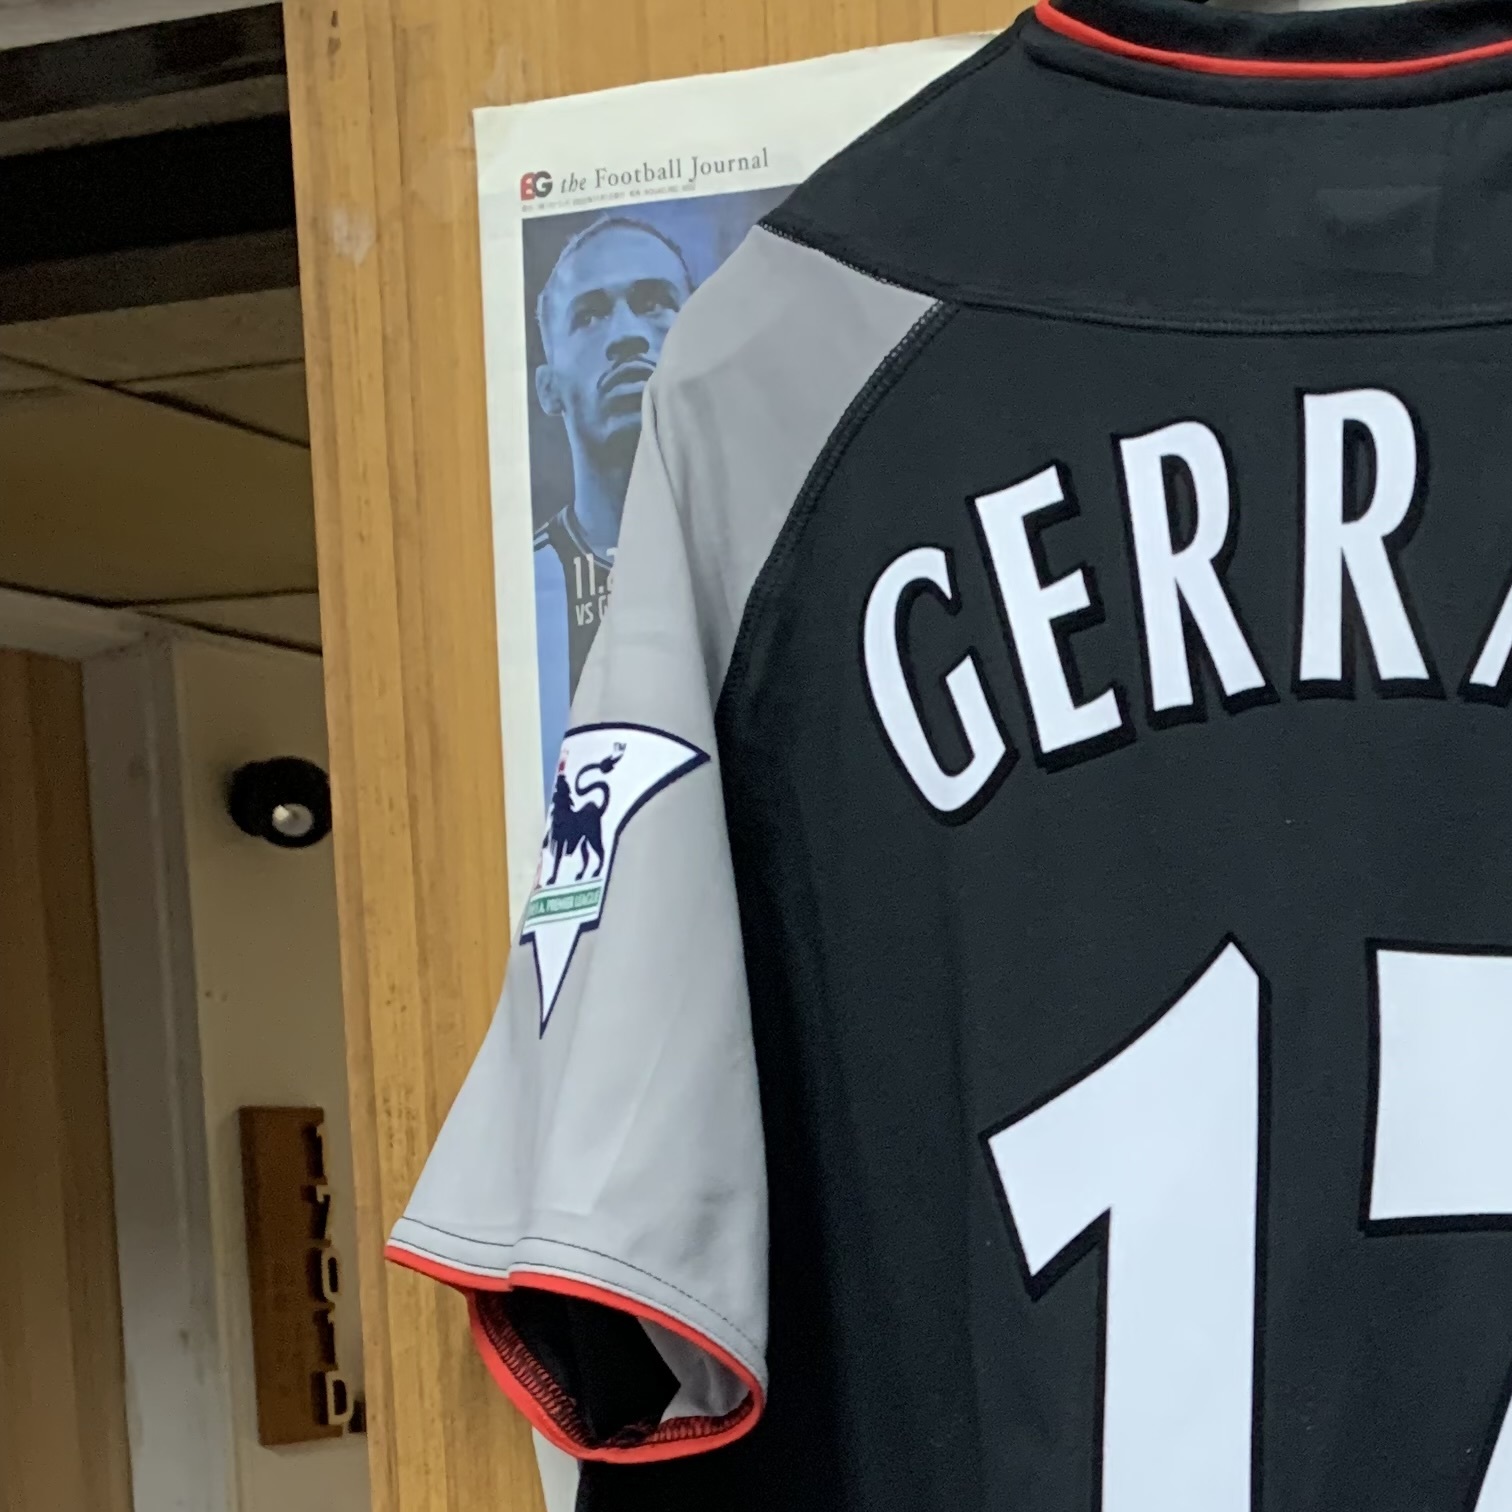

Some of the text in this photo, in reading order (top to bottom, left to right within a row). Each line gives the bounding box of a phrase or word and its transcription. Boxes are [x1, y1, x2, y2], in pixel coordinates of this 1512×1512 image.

[560, 172, 587, 194] the
[594, 159, 682, 189] Football
[688, 147, 769, 183] Journal
